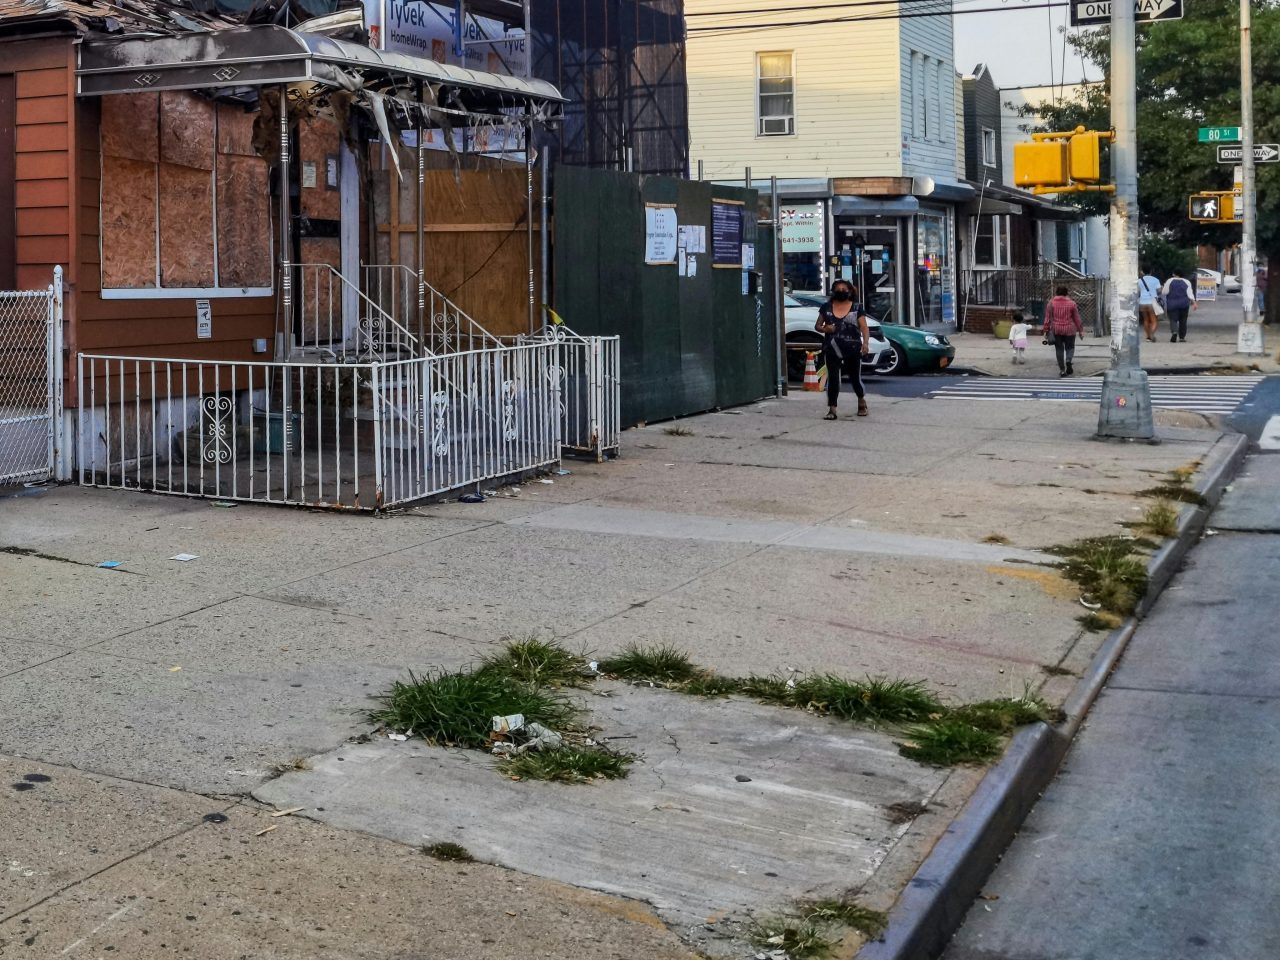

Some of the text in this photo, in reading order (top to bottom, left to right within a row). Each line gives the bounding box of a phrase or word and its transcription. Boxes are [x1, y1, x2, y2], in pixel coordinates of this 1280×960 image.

[391, 30, 427, 52] HomeWrap
[1208, 129, 1220, 140] 80
[1253, 149, 1272, 157] WAY
